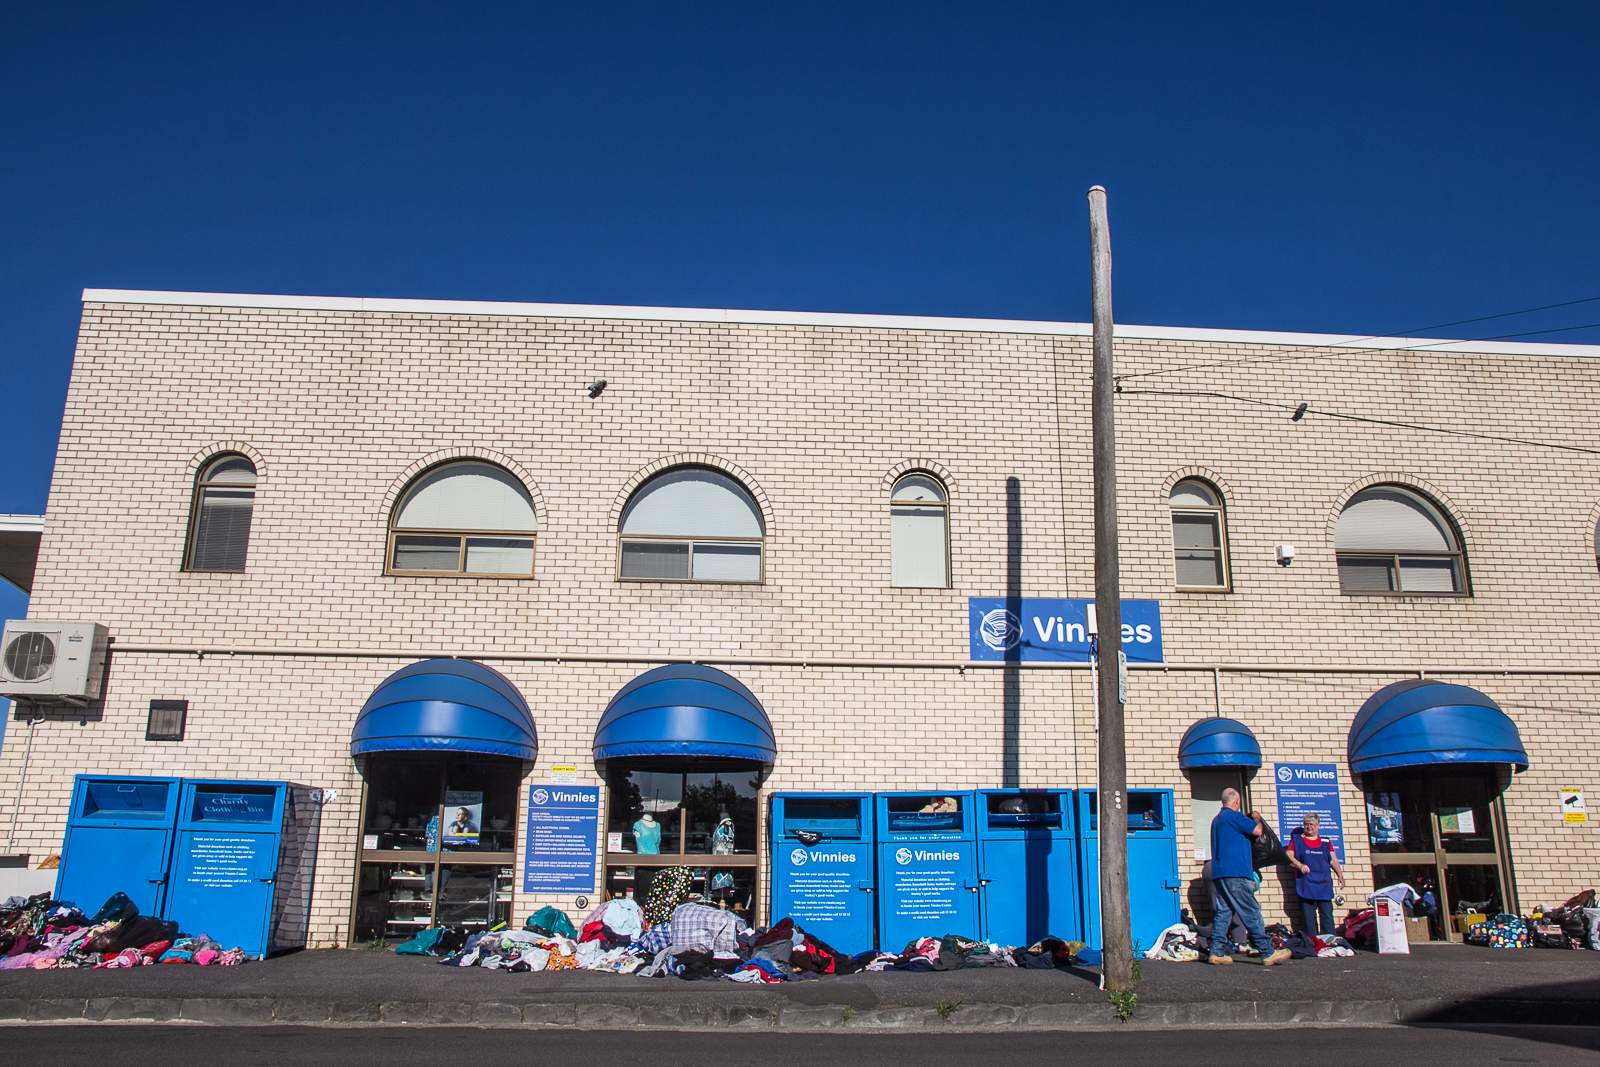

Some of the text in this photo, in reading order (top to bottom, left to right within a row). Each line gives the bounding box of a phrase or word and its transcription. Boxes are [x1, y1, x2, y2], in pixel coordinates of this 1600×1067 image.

[1033, 616, 1153, 643] Vines
[1295, 769, 1335, 779] Vinnies
[552, 791, 596, 803] Vinnies
[810, 851, 857, 862] Vinnies
[914, 850, 960, 861] Vinnies
